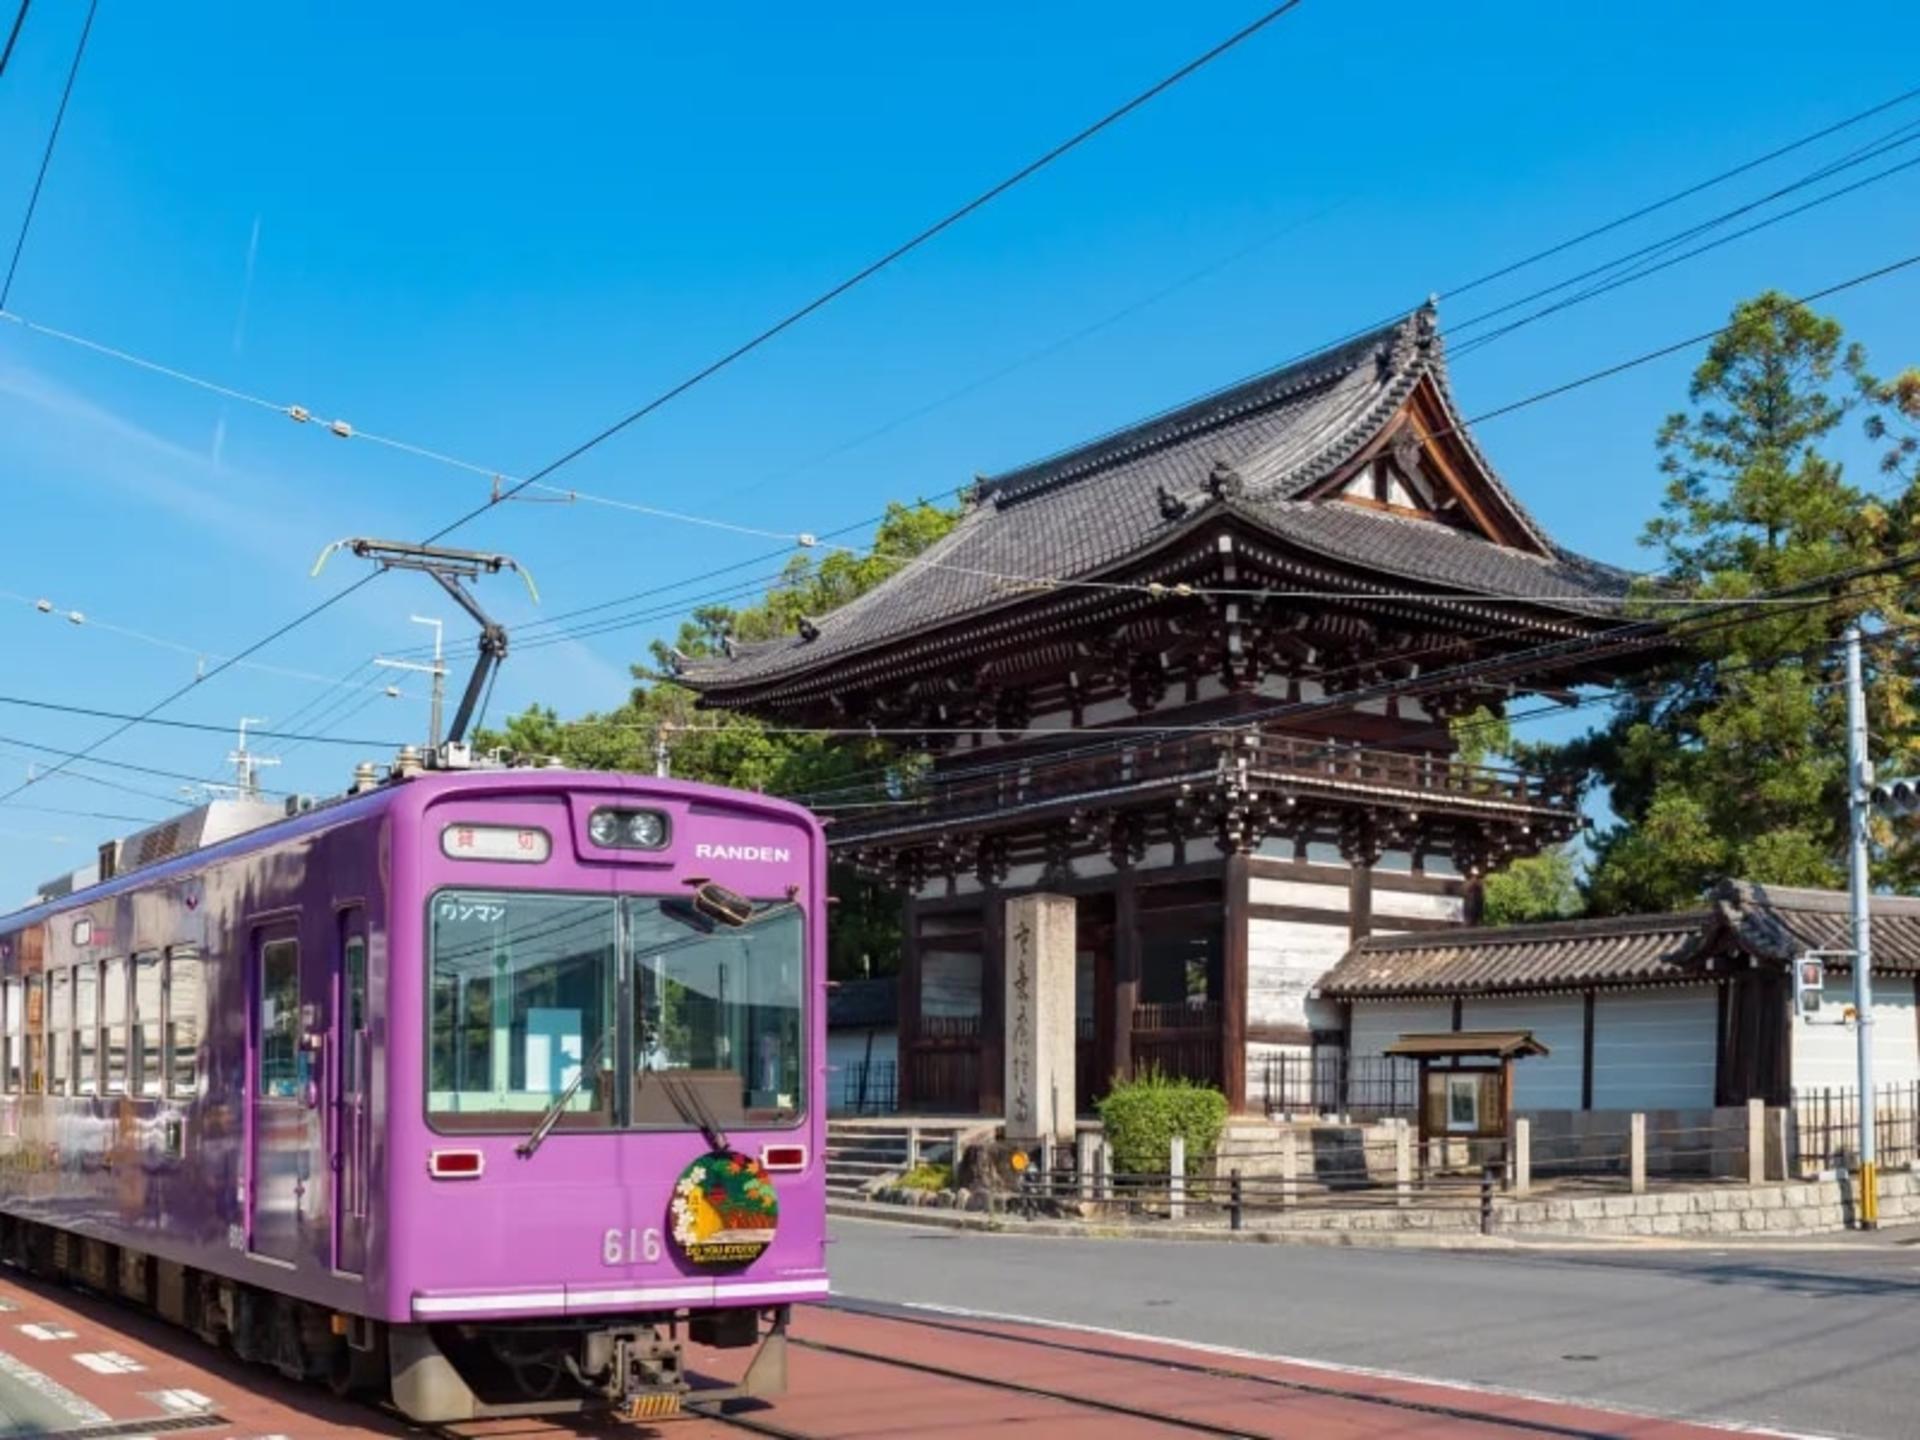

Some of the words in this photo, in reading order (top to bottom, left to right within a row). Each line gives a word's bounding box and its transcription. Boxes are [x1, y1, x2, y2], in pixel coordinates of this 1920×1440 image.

[695, 843, 790, 863] RANDEN
[441, 903, 505, 922] ワンマン
[604, 1228, 661, 1264] 616
